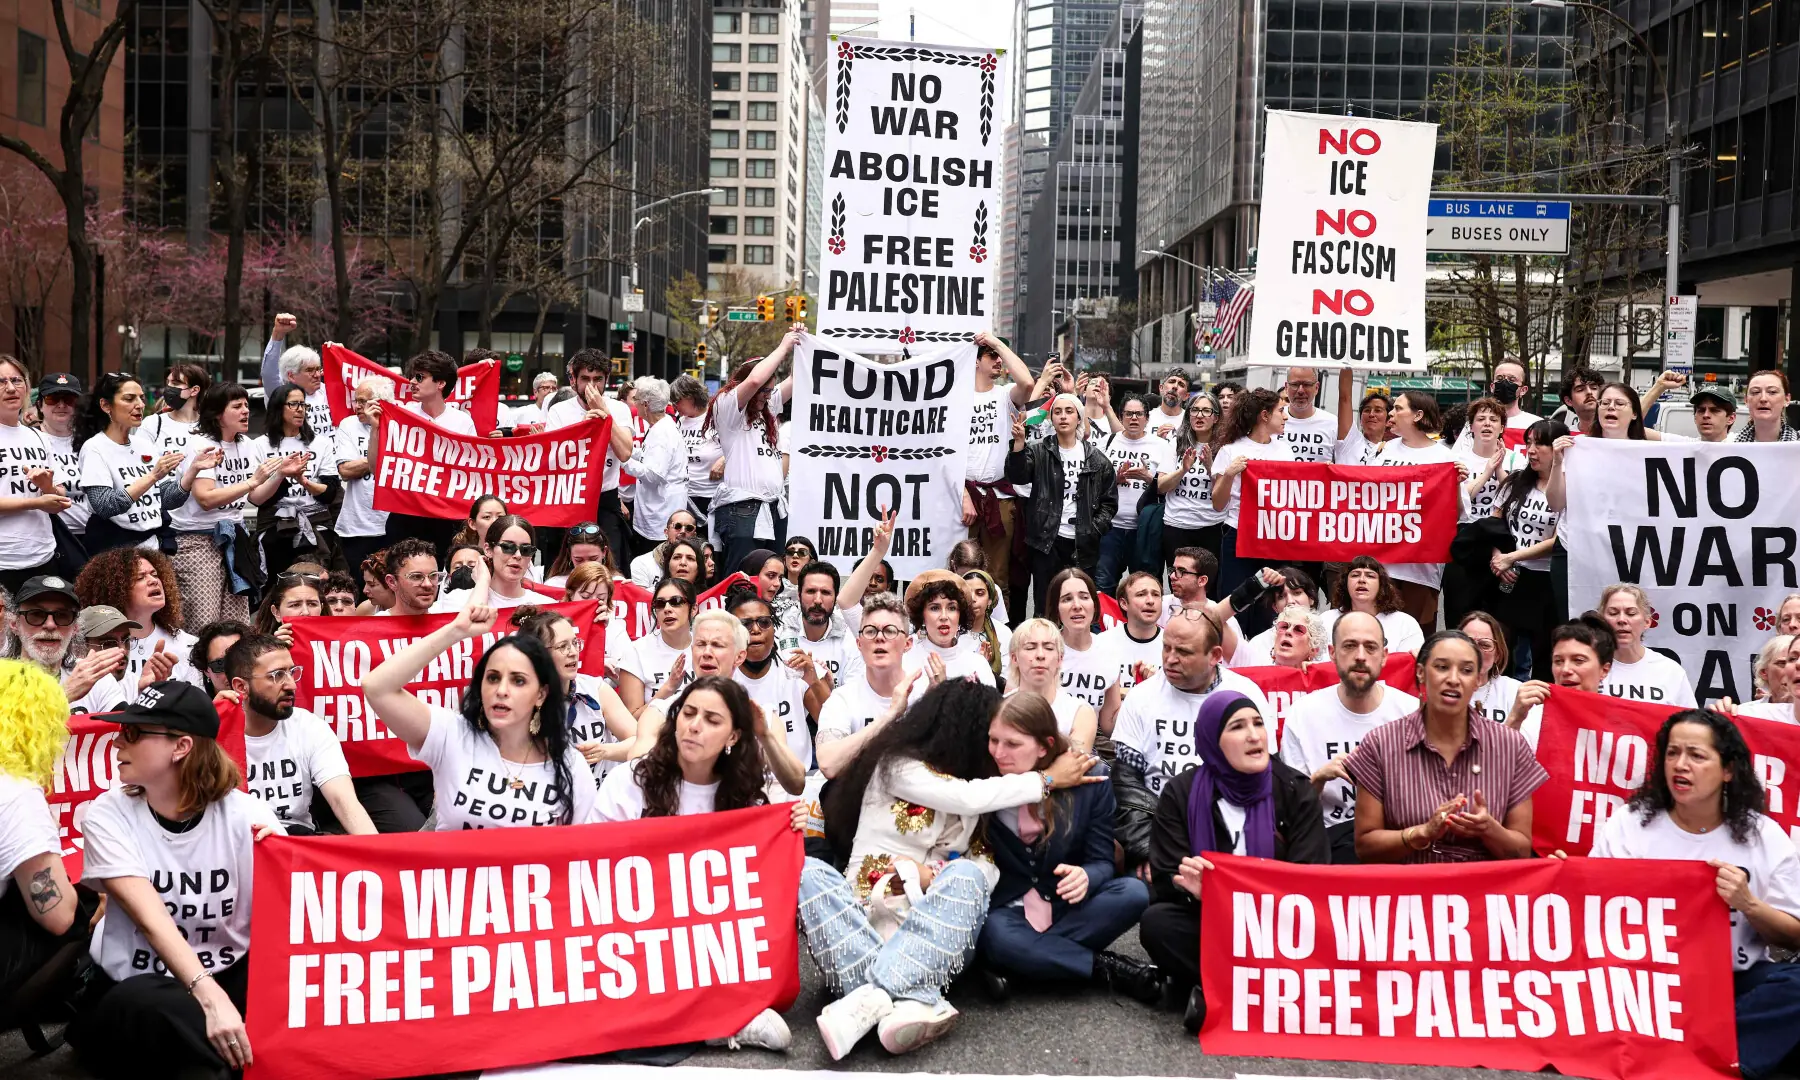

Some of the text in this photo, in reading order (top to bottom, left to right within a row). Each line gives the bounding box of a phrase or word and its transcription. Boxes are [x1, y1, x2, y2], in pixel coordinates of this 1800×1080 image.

[891, 73, 942, 104] NO
[871, 106, 958, 140] WAR
[1318, 128, 1382, 155] NO
[830, 150, 992, 188] ABOLISH
[1329, 159, 1368, 196] ICE
[883, 187, 939, 218] ICE
[1446, 203, 1514, 215] BUS LANE
[1315, 208, 1377, 238] NO
[1451, 226, 1549, 241] BUSES ONLY
[863, 234, 954, 268] FREE
[1291, 239, 1396, 282] FASCISM
[828, 270, 984, 317] PALESTINE
[1312, 288, 1375, 316] NO
[1276, 319, 1411, 364] GENOCIDE
[812, 349, 955, 402] FUND
[809, 403, 948, 437] HEALTHCARE
[970, 410, 998, 424] EOPLE
[973, 400, 997, 414] UND
[164, 437, 187, 447] FU
[682, 429, 702, 438] UND
[968, 434, 1000, 445] OMBS
[970, 423, 994, 436] NOT
[53, 453, 79, 466] UN
[385, 420, 425, 458] NO
[432, 432, 497, 470] WAR
[501, 442, 544, 473] NO
[548, 438, 592, 471] ICE
[1109, 449, 1150, 460] FUND
[1291, 445, 1324, 456] OPLE
[11, 480, 39, 494] NO
[378, 455, 586, 505] FREE PALESTINE
[1179, 477, 1211, 488] NOT
[1257, 478, 1424, 511] FUND PEOPLE
[1644, 455, 1760, 519] NO
[823, 472, 930, 521] NOT
[128, 508, 162, 524] BOM
[1257, 509, 1422, 544] NOT BOMBS
[1510, 519, 1545, 537] NOT
[1520, 509, 1556, 526] OPLE
[818, 526, 932, 557] WARARE
[1607, 525, 1799, 588] WAR
[1672, 602, 1738, 637] ON
[309, 640, 372, 689] NO
[1060, 672, 1106, 690] UND
[313, 693, 398, 742] FRE
[570, 721, 604, 744] ND
[1156, 719, 1197, 738] FU
[247, 758, 297, 783] UND
[1161, 760, 1198, 777] NO
[1574, 727, 1649, 790] NO
[248, 782, 303, 801] OPLE
[466, 767, 562, 806] FUND
[152, 868, 230, 896] UND
[288, 845, 764, 946] NO WAR NO ICE
[164, 897, 233, 920] OPLE
[177, 926, 217, 943] OT
[1231, 891, 1679, 965] NO WAR NO ICE
[131, 945, 236, 976] BOBS
[287, 914, 772, 1029] FREE PALESTINE
[1231, 966, 1685, 1042] FREE PALESTINE
